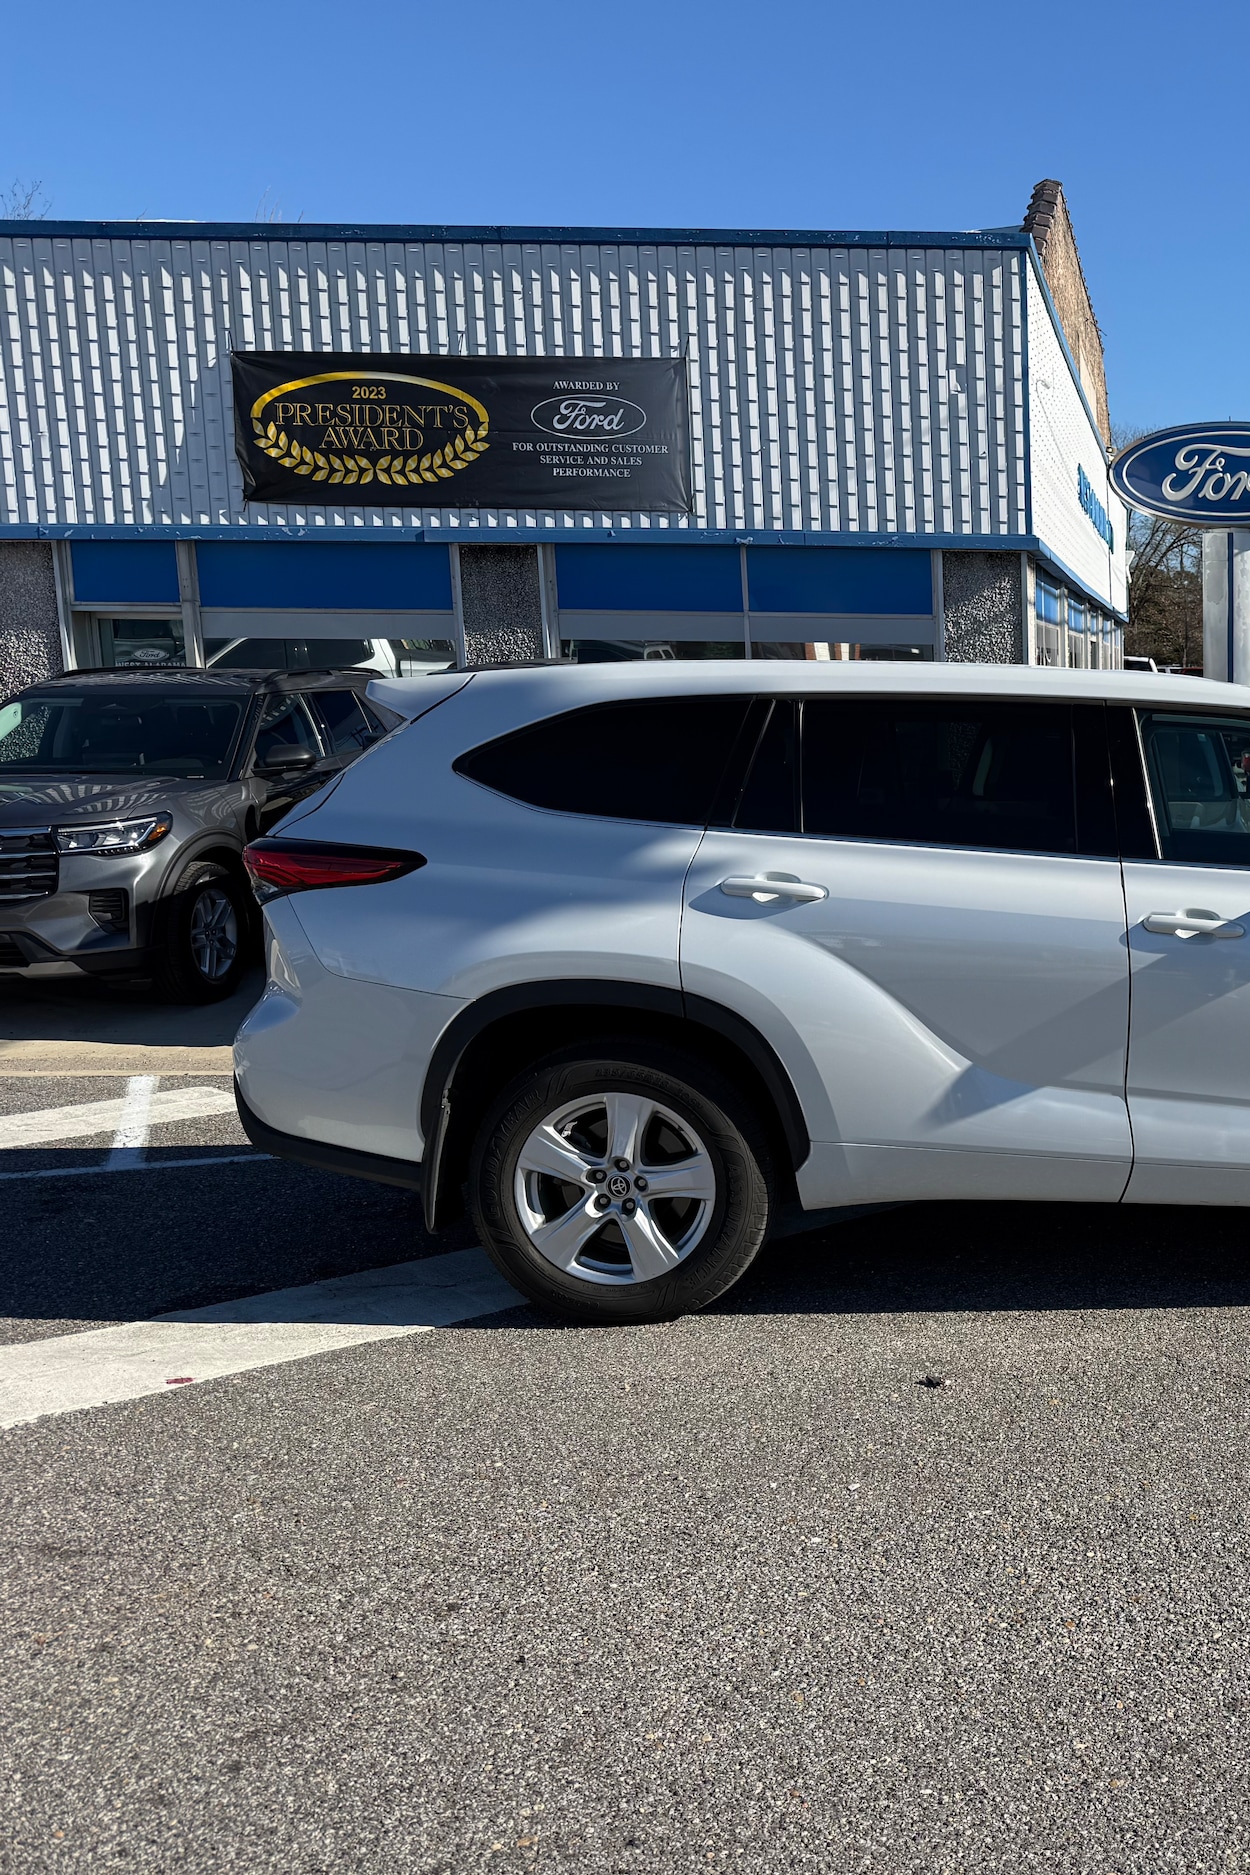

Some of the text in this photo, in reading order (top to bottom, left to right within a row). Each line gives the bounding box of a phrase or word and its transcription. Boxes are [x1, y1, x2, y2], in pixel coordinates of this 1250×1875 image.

[553, 381, 620, 391] AWARDED BY
[352, 386, 386, 399] 2023
[274, 402, 469, 429] PRESIDENT'S
[552, 400, 625, 430] Ford
[318, 426, 424, 451] AWARD
[512, 442, 668, 454] FOR OUTSTANDING CUSTOMER
[540, 455, 643, 466] SERVICE AND SALES
[553, 467, 631, 478] PERFORMANCE
